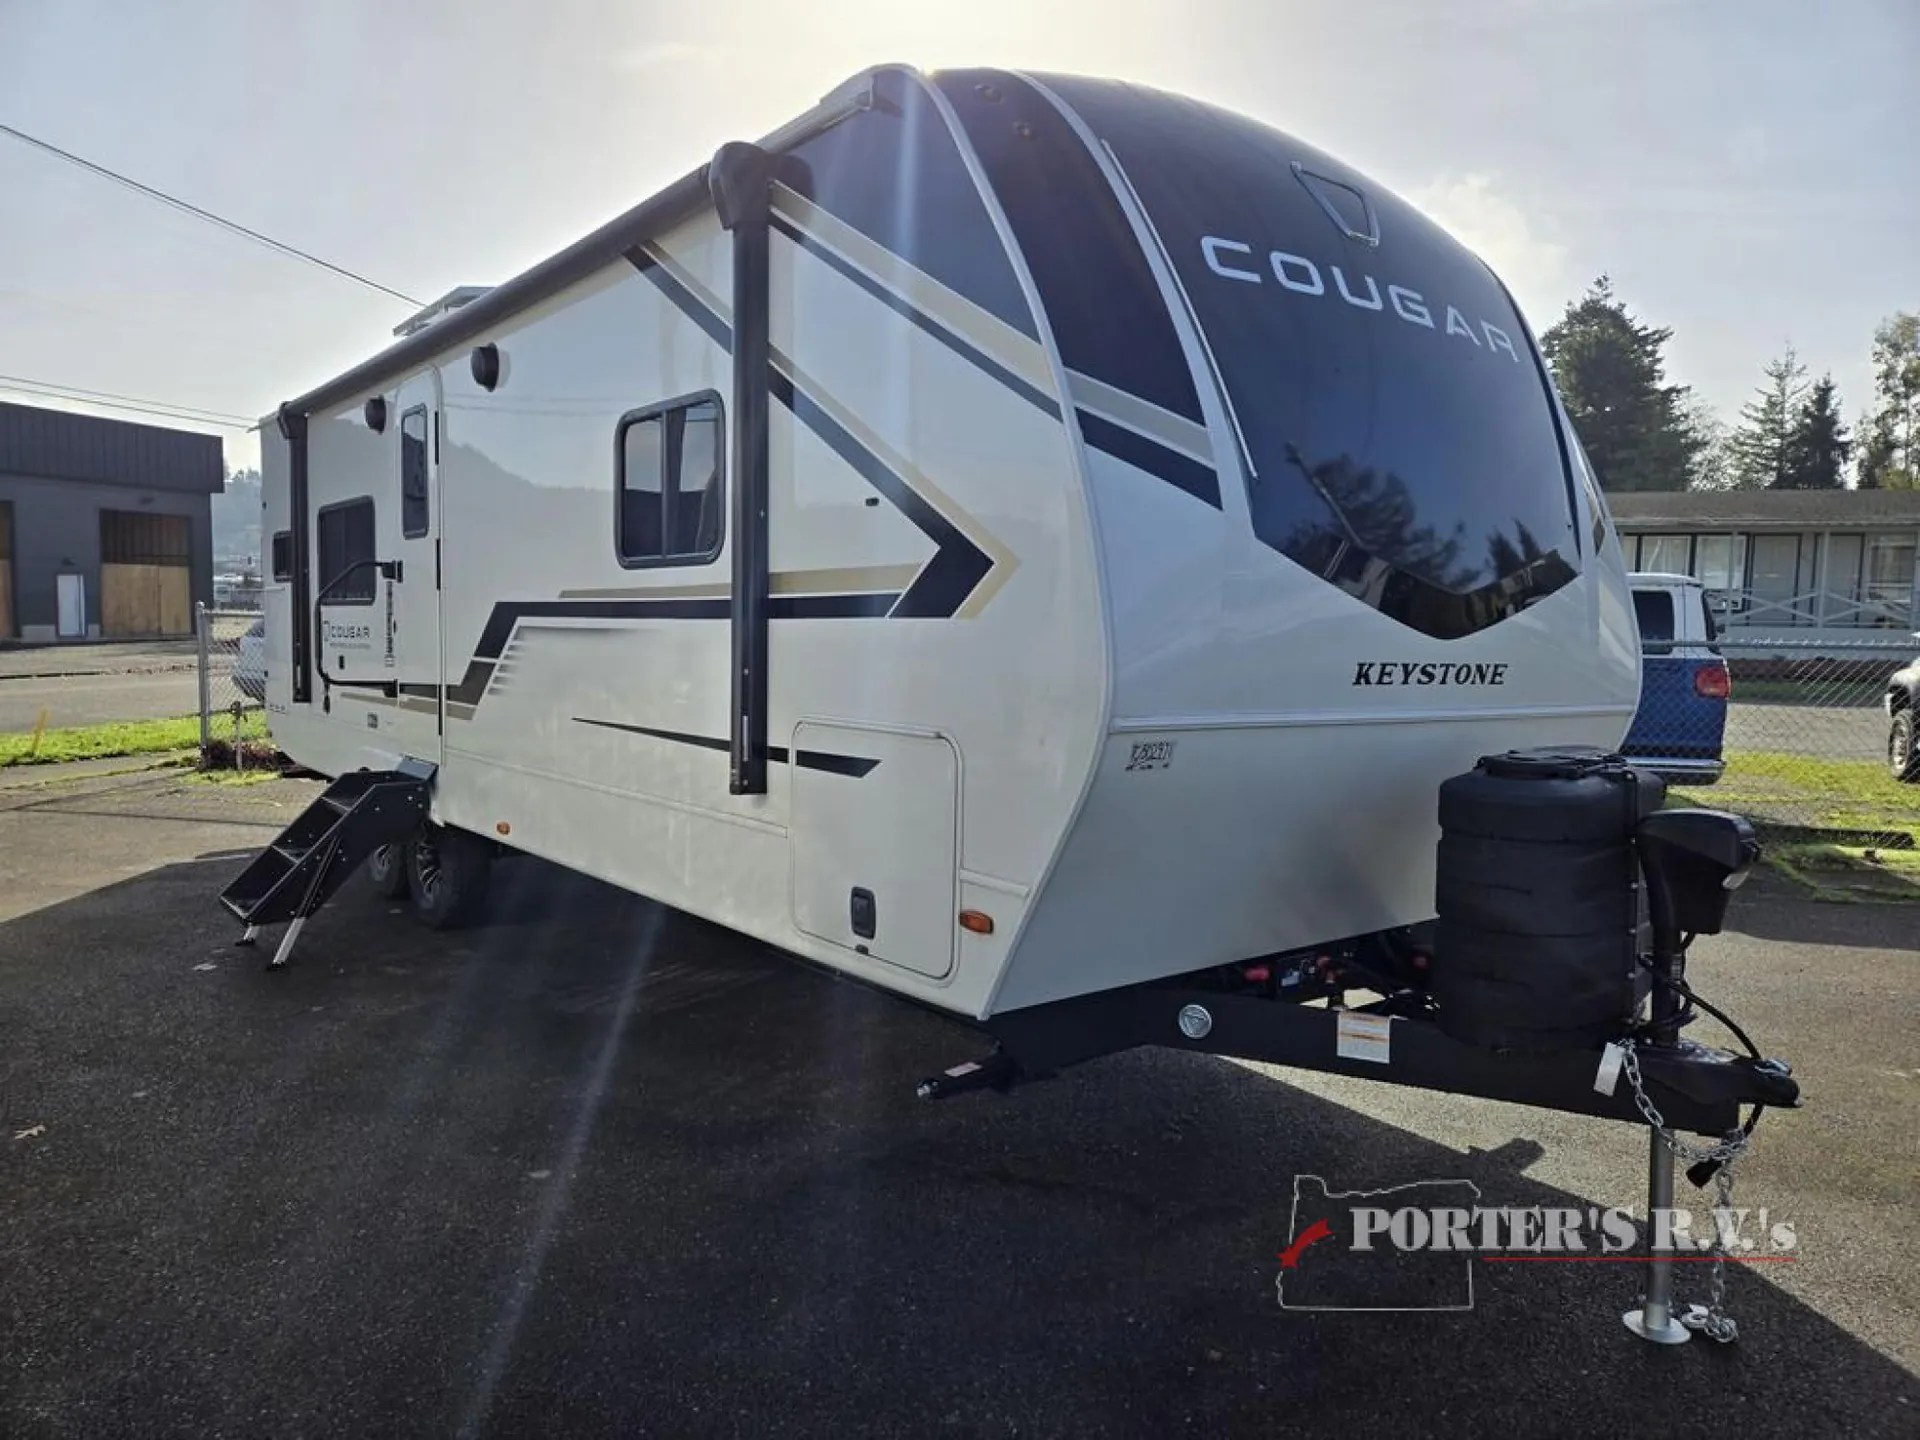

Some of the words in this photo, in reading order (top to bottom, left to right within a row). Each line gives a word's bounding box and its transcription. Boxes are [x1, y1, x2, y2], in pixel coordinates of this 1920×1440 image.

[1201, 235, 1521, 362] COUGAR
[330, 625, 371, 639] COUGAR
[1352, 661, 1509, 686] KEYSTONE
